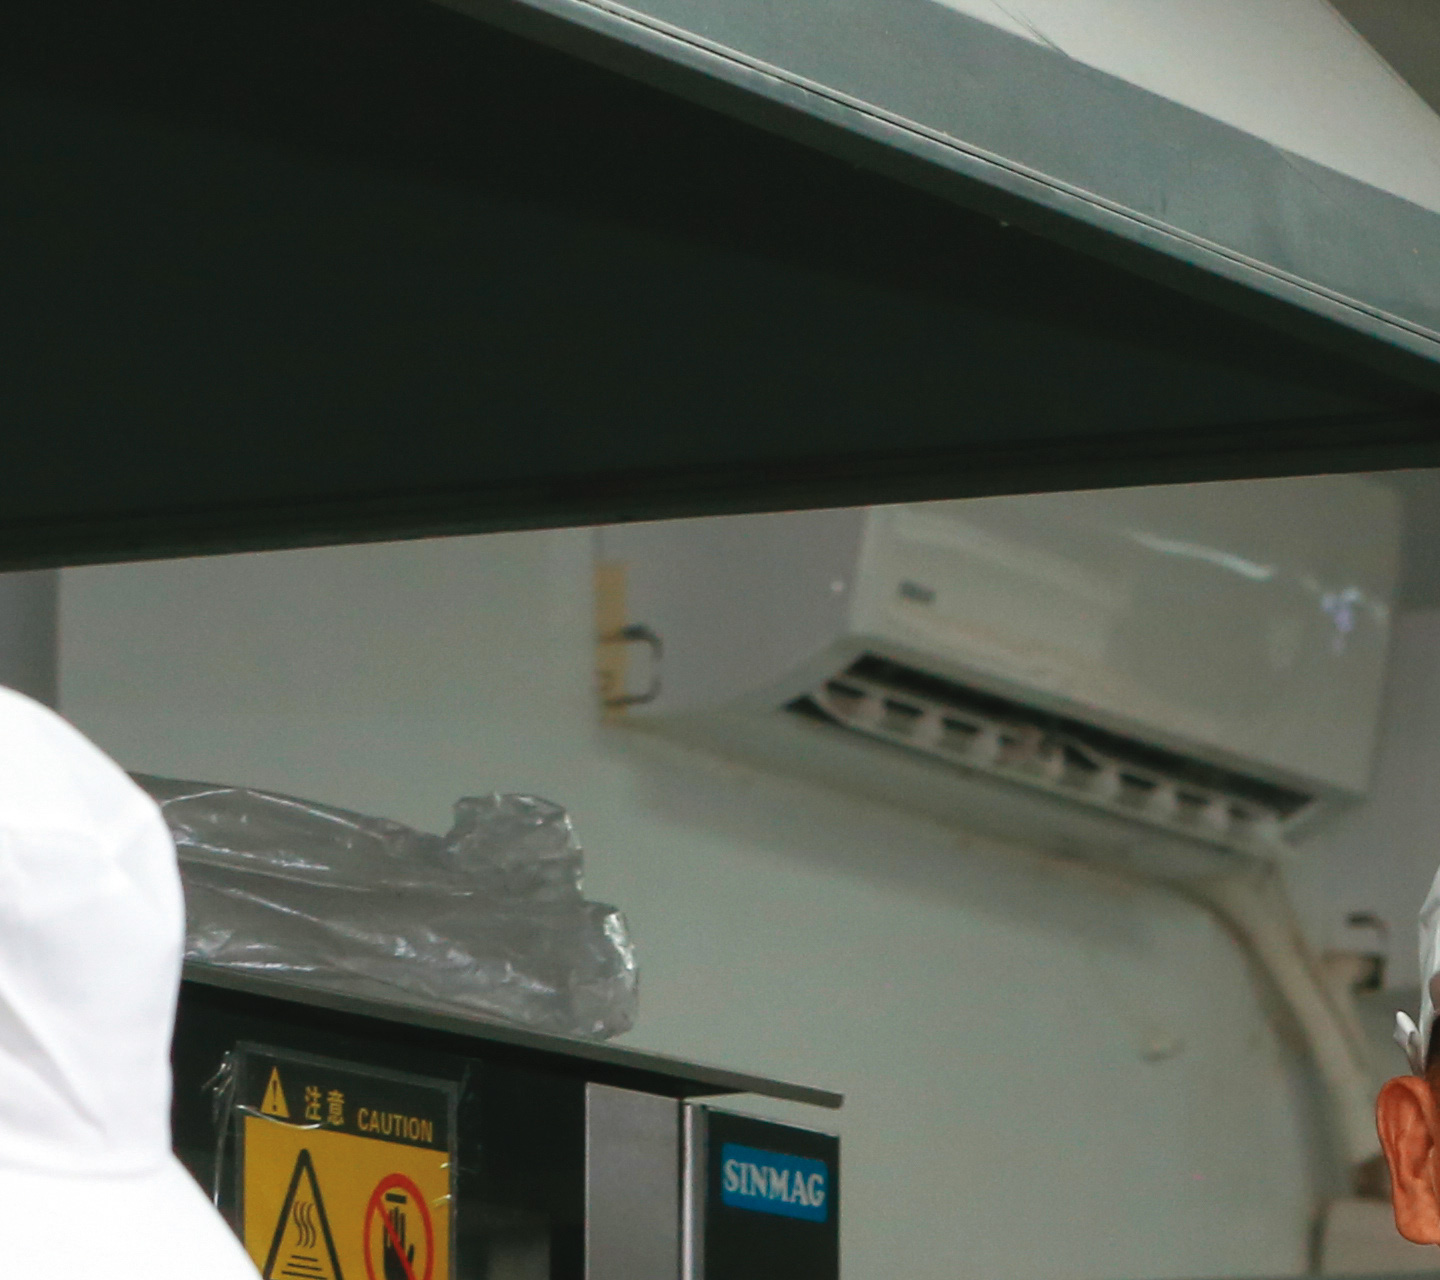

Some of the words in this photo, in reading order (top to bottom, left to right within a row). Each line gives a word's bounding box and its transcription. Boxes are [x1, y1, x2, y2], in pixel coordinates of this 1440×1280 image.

[304, 1085, 345, 1126] 注意
[357, 1107, 433, 1142] CAUTION
[723, 1158, 825, 1207] SINMAG
